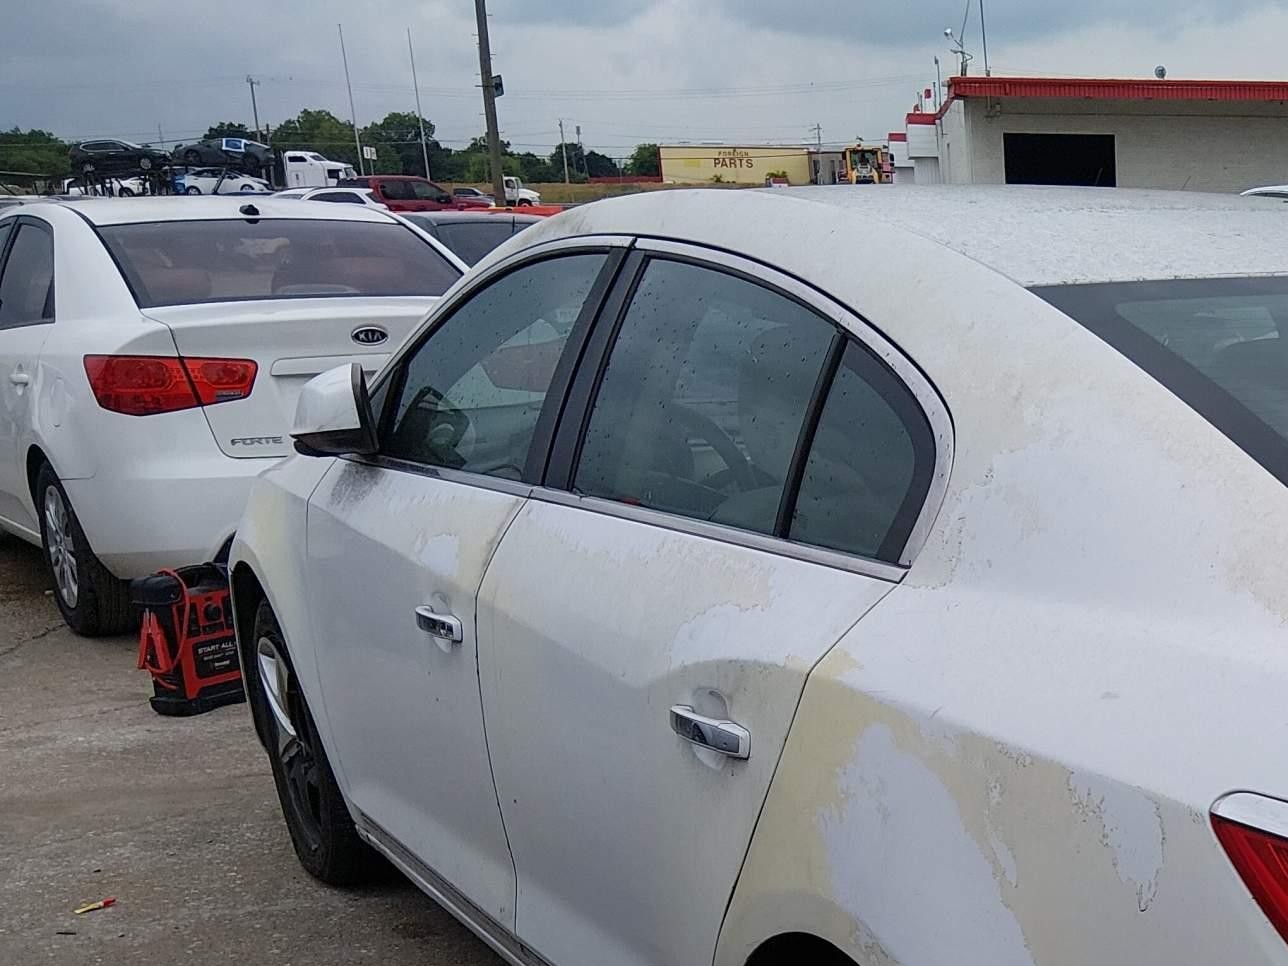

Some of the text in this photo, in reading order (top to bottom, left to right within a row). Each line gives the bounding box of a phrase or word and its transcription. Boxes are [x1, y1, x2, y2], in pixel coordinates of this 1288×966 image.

[713, 158, 754, 169] PARTS
[358, 331, 383, 341] KIA
[230, 436, 284, 446] FORTE
